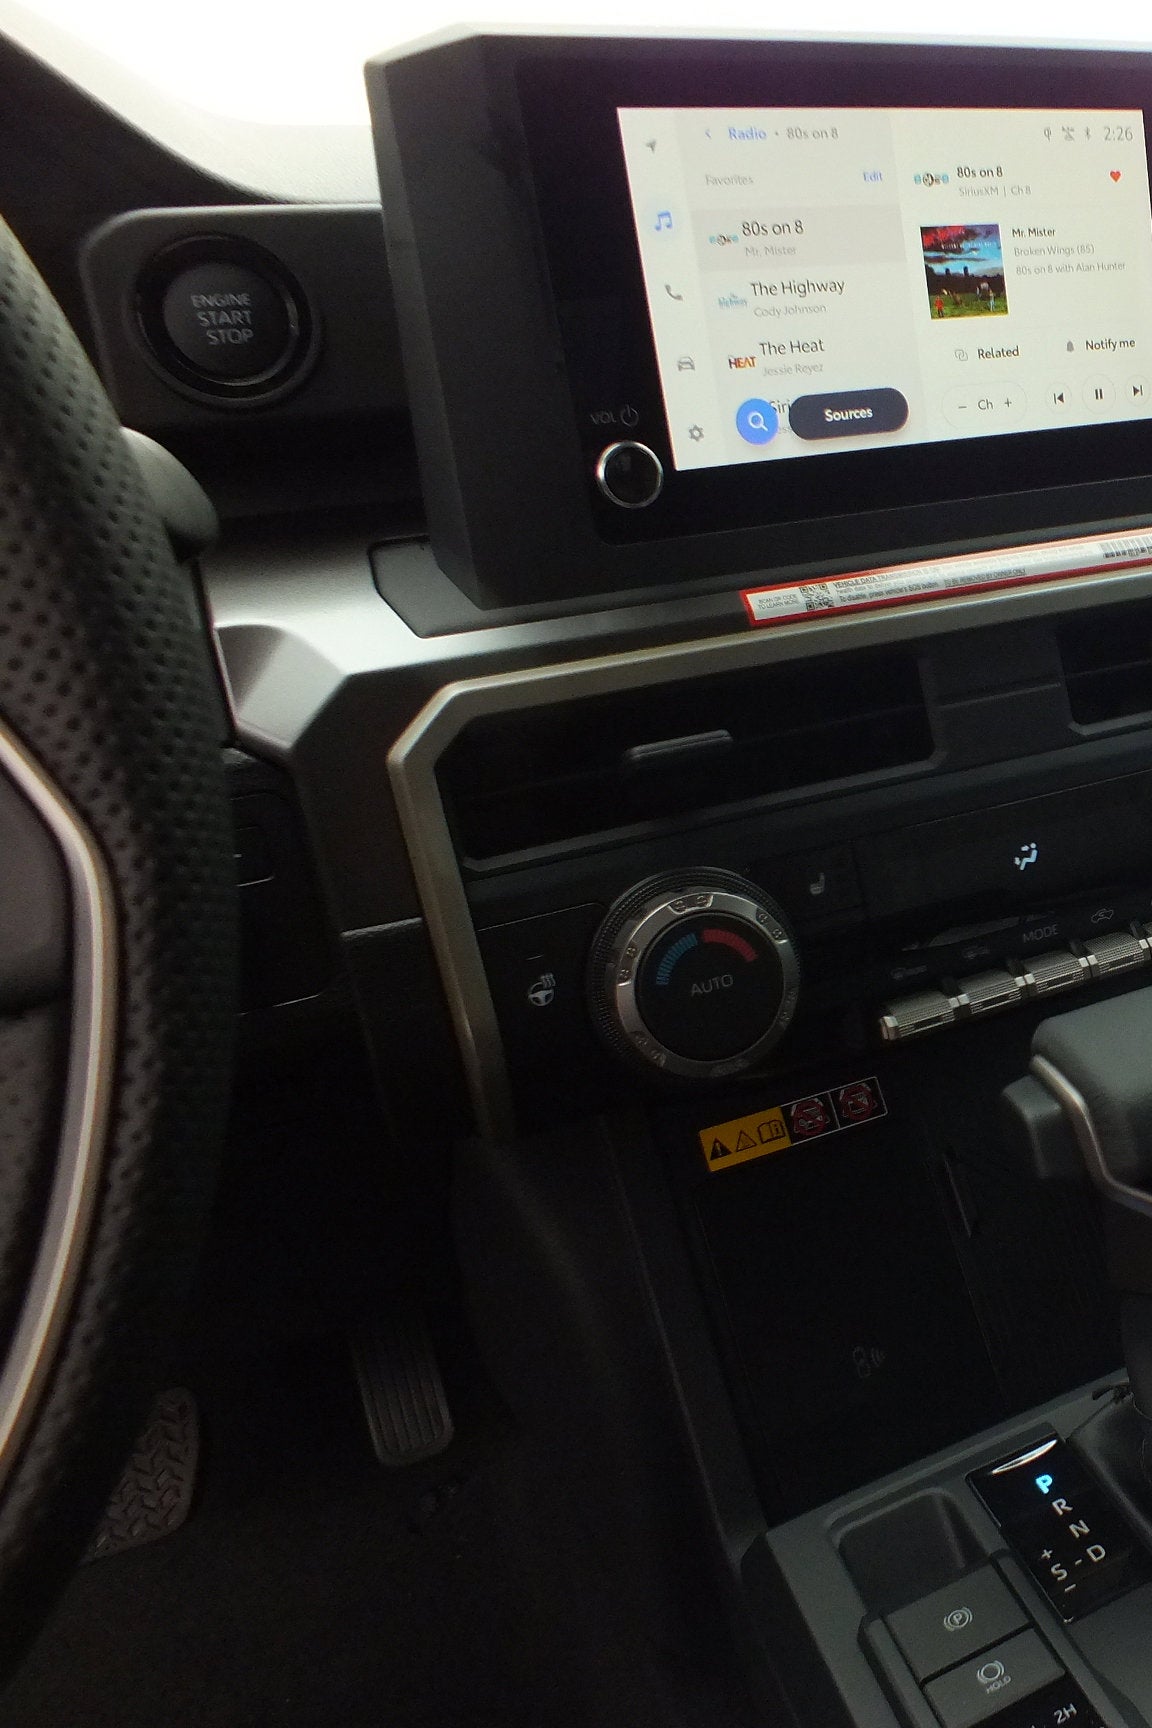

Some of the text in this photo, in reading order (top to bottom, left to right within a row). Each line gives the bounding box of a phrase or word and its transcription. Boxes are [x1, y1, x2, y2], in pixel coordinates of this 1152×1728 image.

[728, 127, 839, 141] Radio 80s on 8
[1104, 126, 1133, 141] 2:26
[863, 170, 883, 182] Edit
[957, 166, 1003, 178] 80s on 8
[705, 174, 754, 187] Favorites
[742, 219, 804, 237] 80s on 8
[1012, 226, 1056, 239] Mr. Mister
[1014, 247, 1045, 258] Broken
[751, 278, 845, 299] The Highway
[191, 293, 251, 308] ENGINE
[198, 310, 251, 327] START
[207, 329, 254, 345] STOP
[760, 339, 825, 355] The Heat
[977, 345, 1019, 360] Related
[1086, 338, 1135, 352] Notify me
[728, 356, 756, 369] HEAT
[977, 399, 993, 411] Ch
[824, 407, 873, 422] Sources
[1022, 924, 1058, 943] MODE
[691, 974, 734, 997] AUTO
[1035, 1474, 1053, 1494] P
[1052, 1498, 1074, 1516] R
[1068, 1520, 1091, 1539] N
[1086, 1544, 1106, 1562] D
[1051, 1563, 1068, 1581] S
[1053, 1703, 1078, 1724] 2H
